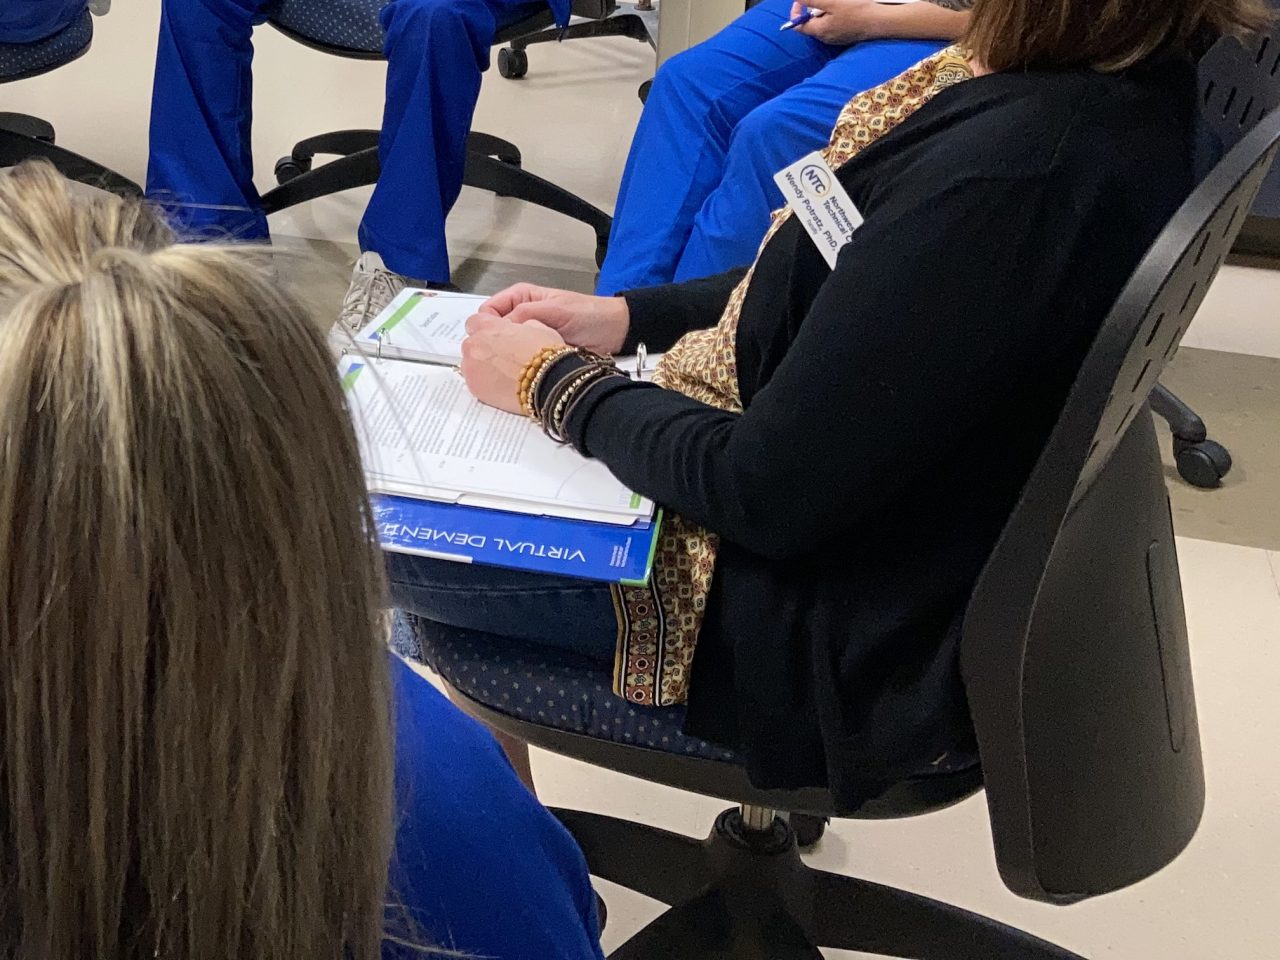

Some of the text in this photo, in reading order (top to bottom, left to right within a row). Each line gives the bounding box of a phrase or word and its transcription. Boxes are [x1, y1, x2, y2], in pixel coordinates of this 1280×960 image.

[785, 171, 804, 199] Wendy
[805, 169, 826, 194] NTC
[823, 200, 848, 234] Technical
[829, 195, 855, 232] Northwes
[494, 538, 586, 563] VIRTUAL
